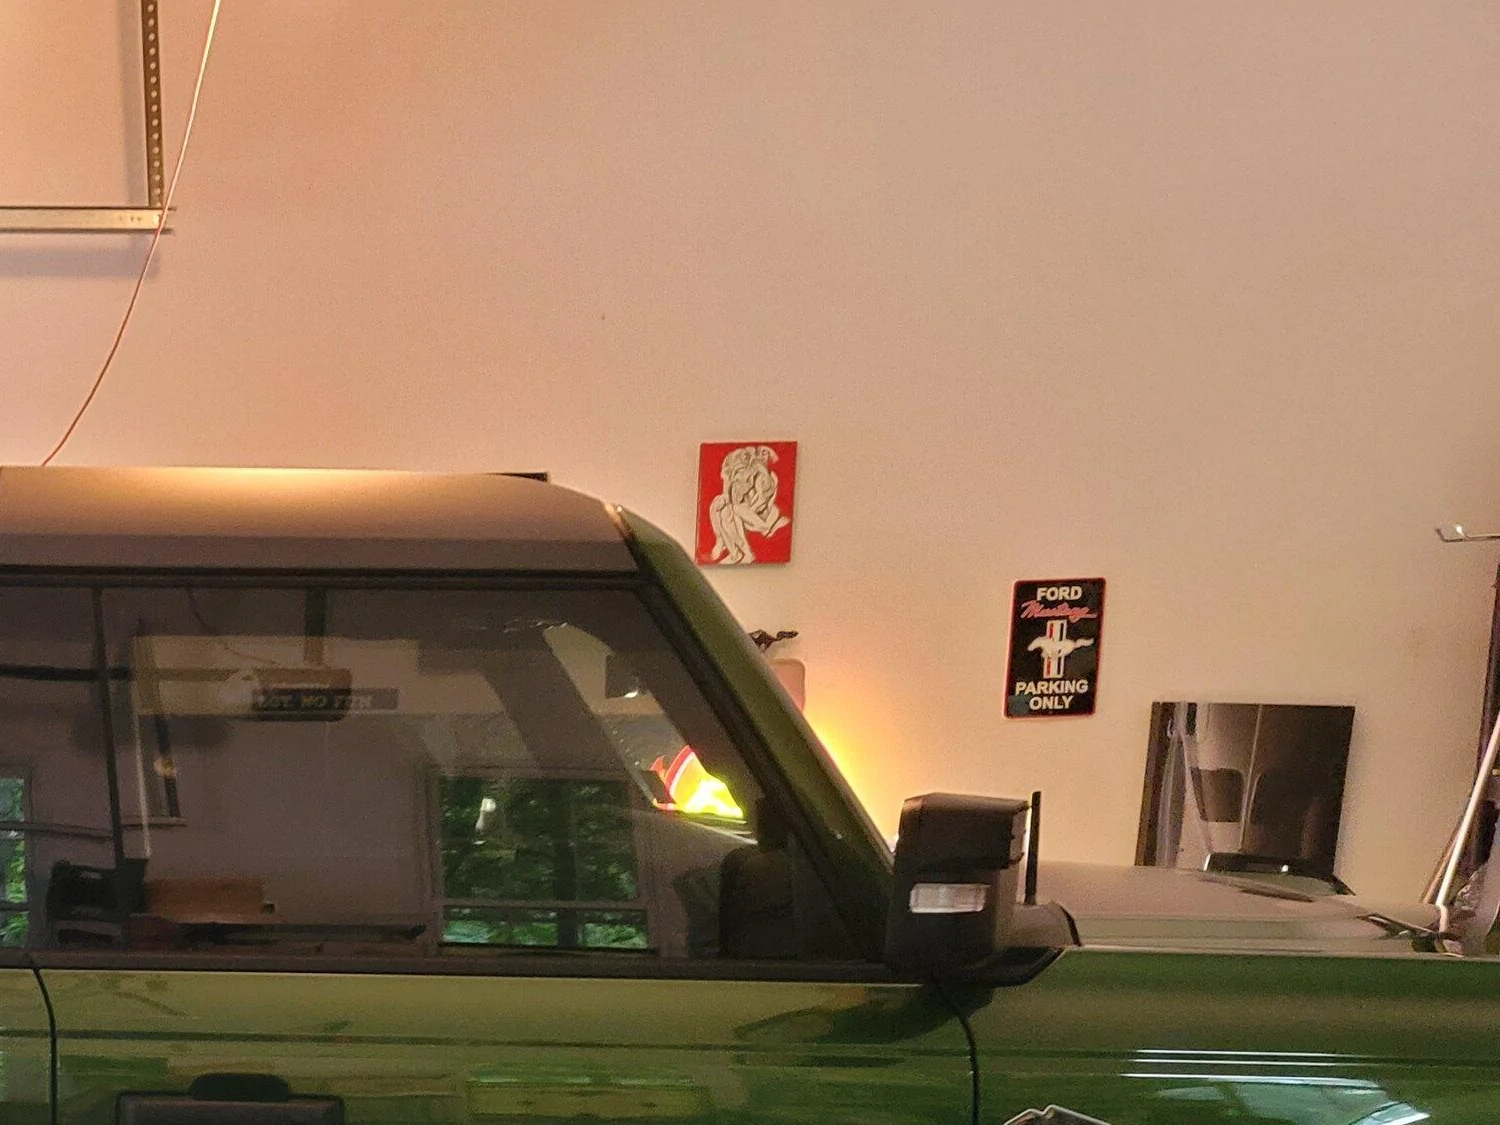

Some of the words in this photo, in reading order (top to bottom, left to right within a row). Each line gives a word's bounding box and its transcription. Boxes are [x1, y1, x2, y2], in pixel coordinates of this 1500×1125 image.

[1036, 586, 1083, 601] FORD
[1015, 679, 1089, 695] PARKING
[1028, 695, 1073, 710] ONLY
